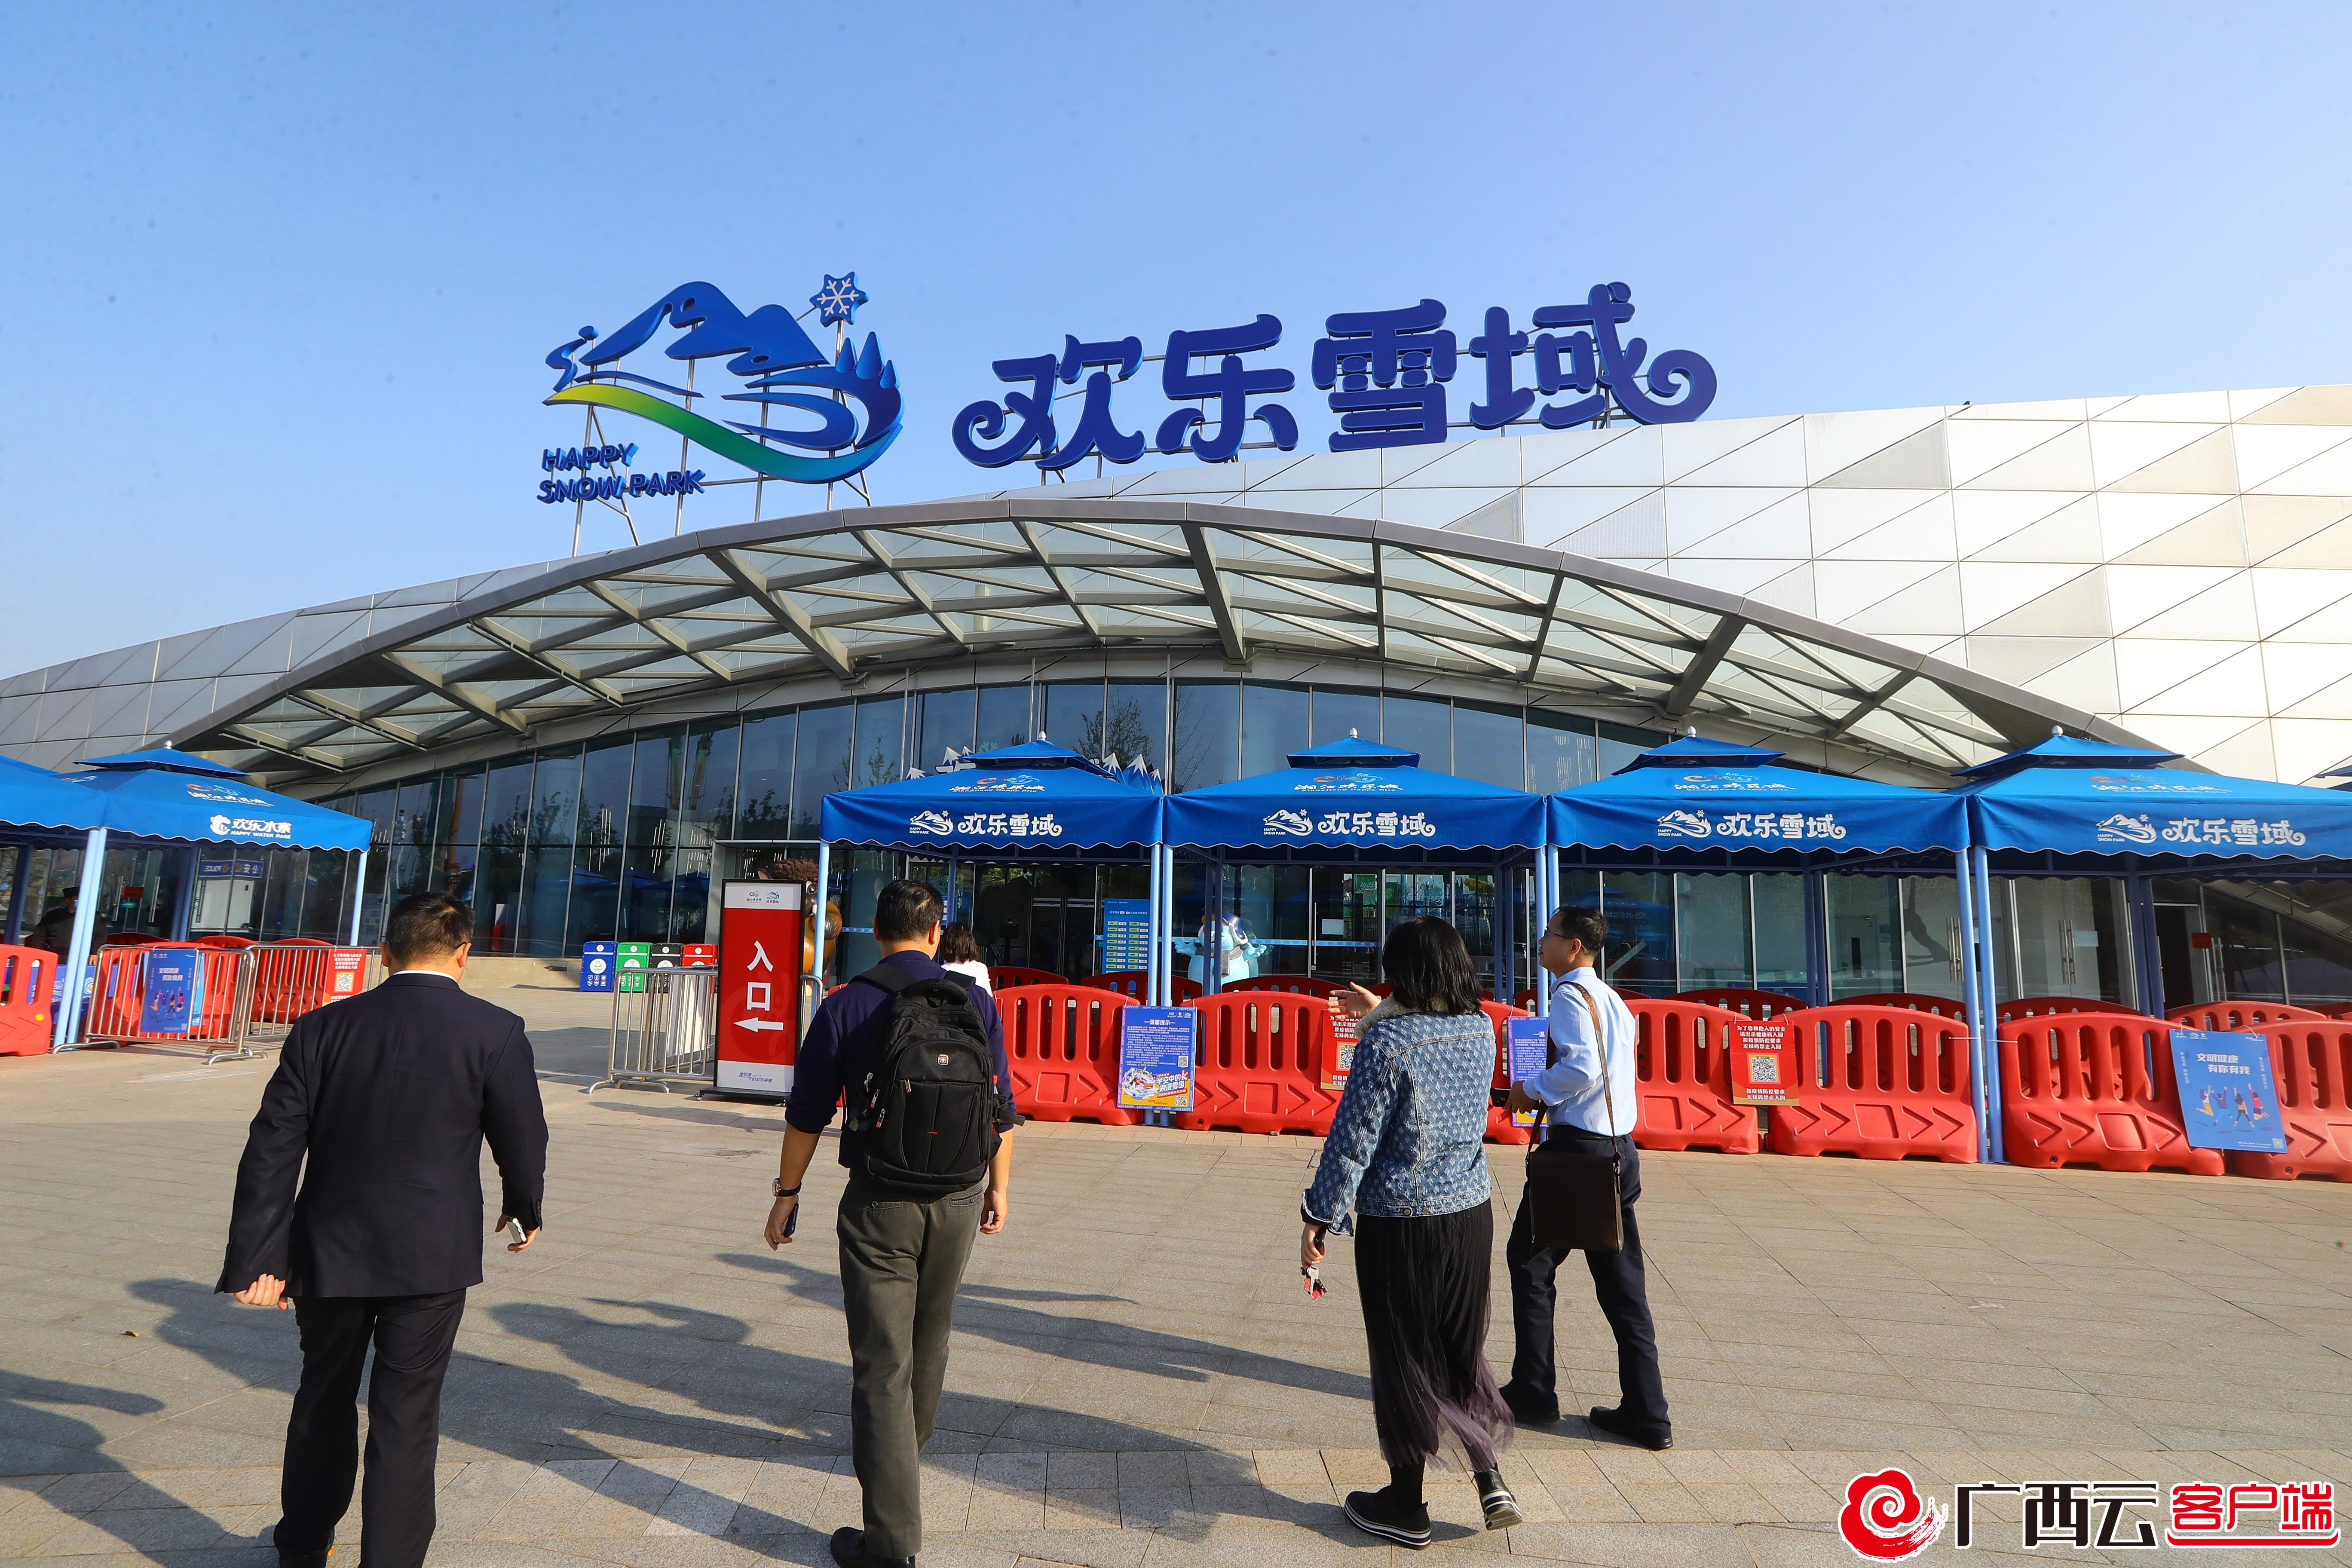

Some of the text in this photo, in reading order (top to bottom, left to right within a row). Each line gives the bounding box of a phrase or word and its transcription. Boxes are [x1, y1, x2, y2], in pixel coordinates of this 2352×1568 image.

[952, 282, 1717, 471] 欢乐雪域
[542, 443, 639, 472] HAPPY
[536, 469, 706, 504] SNOW PARK
[232, 818, 292, 833] 欢乐水寨
[958, 812, 1063, 837] 欢乐雪域
[1317, 811, 1436, 837] 欢乐雪域
[1716, 812, 1847, 839] 欢乐雪域
[2162, 817, 2306, 846] 欢乐雪域
[747, 940, 774, 1012] 入口
[2196, 1053, 2239, 1064] 文明健康
[2208, 1064, 2250, 1075] 有你有我
[1157, 1074, 1181, 1084] 半空中的
[1159, 1080, 1185, 1092] 浪漫雪国
